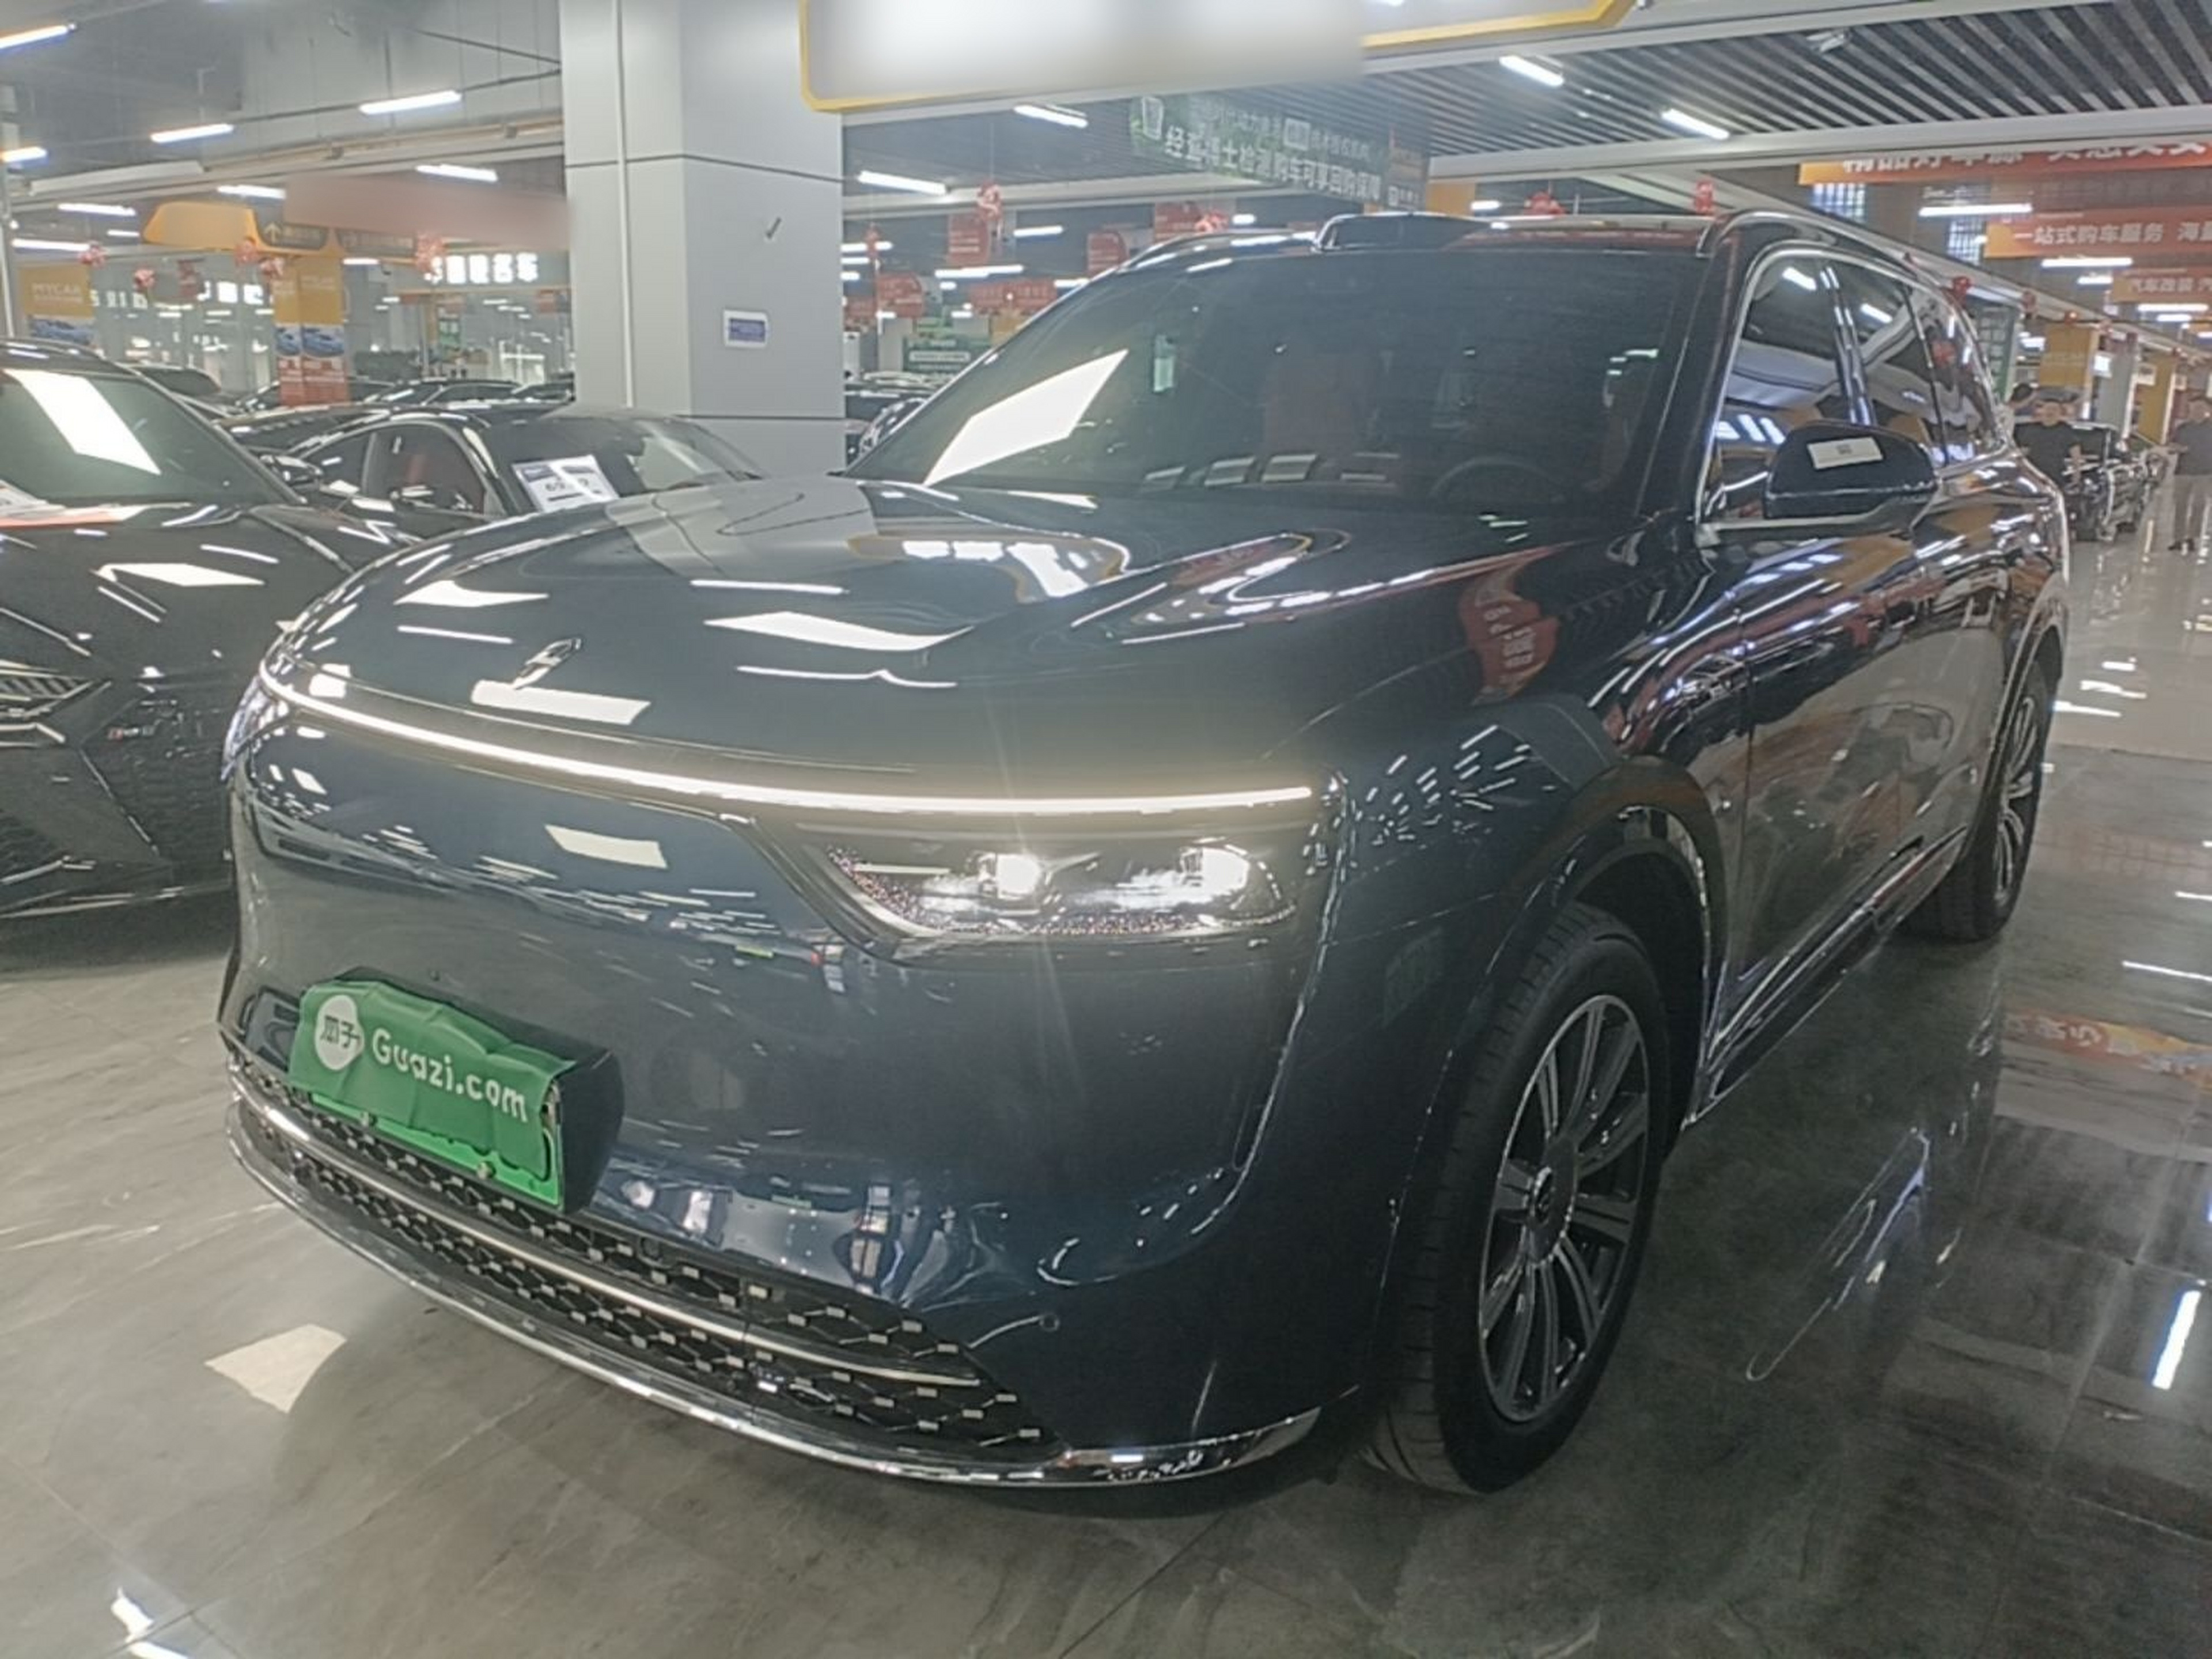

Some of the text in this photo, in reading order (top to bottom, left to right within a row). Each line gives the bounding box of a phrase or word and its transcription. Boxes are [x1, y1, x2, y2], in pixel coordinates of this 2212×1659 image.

[2013, 222, 2163, 245] 一站式购车服务
[320, 1014, 360, 1049] 瓜子
[372, 1028, 529, 1123] Guazi.com
